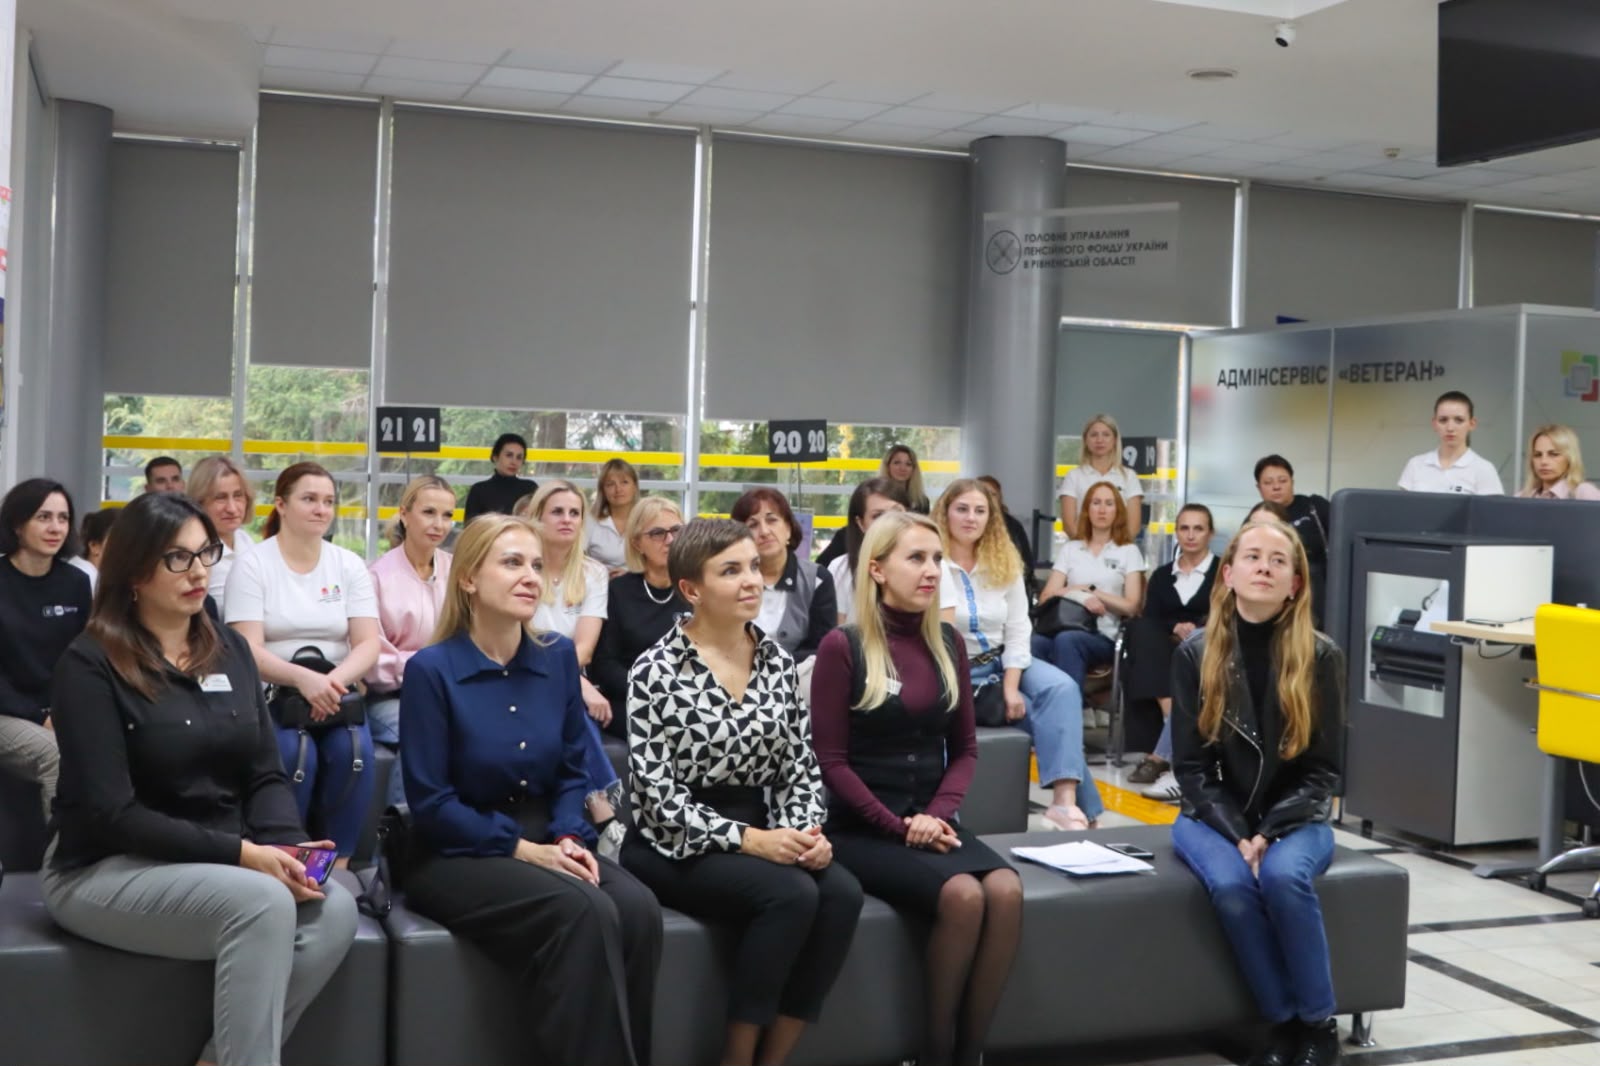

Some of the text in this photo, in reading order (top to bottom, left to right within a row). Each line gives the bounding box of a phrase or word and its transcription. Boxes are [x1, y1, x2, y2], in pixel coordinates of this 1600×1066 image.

[1024, 229, 1130, 243] ГОЛОВНЕ УПРАВЛІННЯ
[1024, 241, 1168, 256] ПЕНСІЙНОГО ФОНДУ УКРАЇНИ
[1024, 256, 1135, 269] В РІВНЕНСЬКІЙ ОБЛАСТІ
[1217, 360, 1445, 388] АДМІНСЕРВІС «ВЕТЕРАН»
[381, 416, 403, 441] 21
[413, 417, 435, 442] 21
[772, 430, 802, 454] 20
[808, 430, 825, 453] 20
[1123, 445, 1138, 467] 9
[1145, 445, 1155, 467] 19
